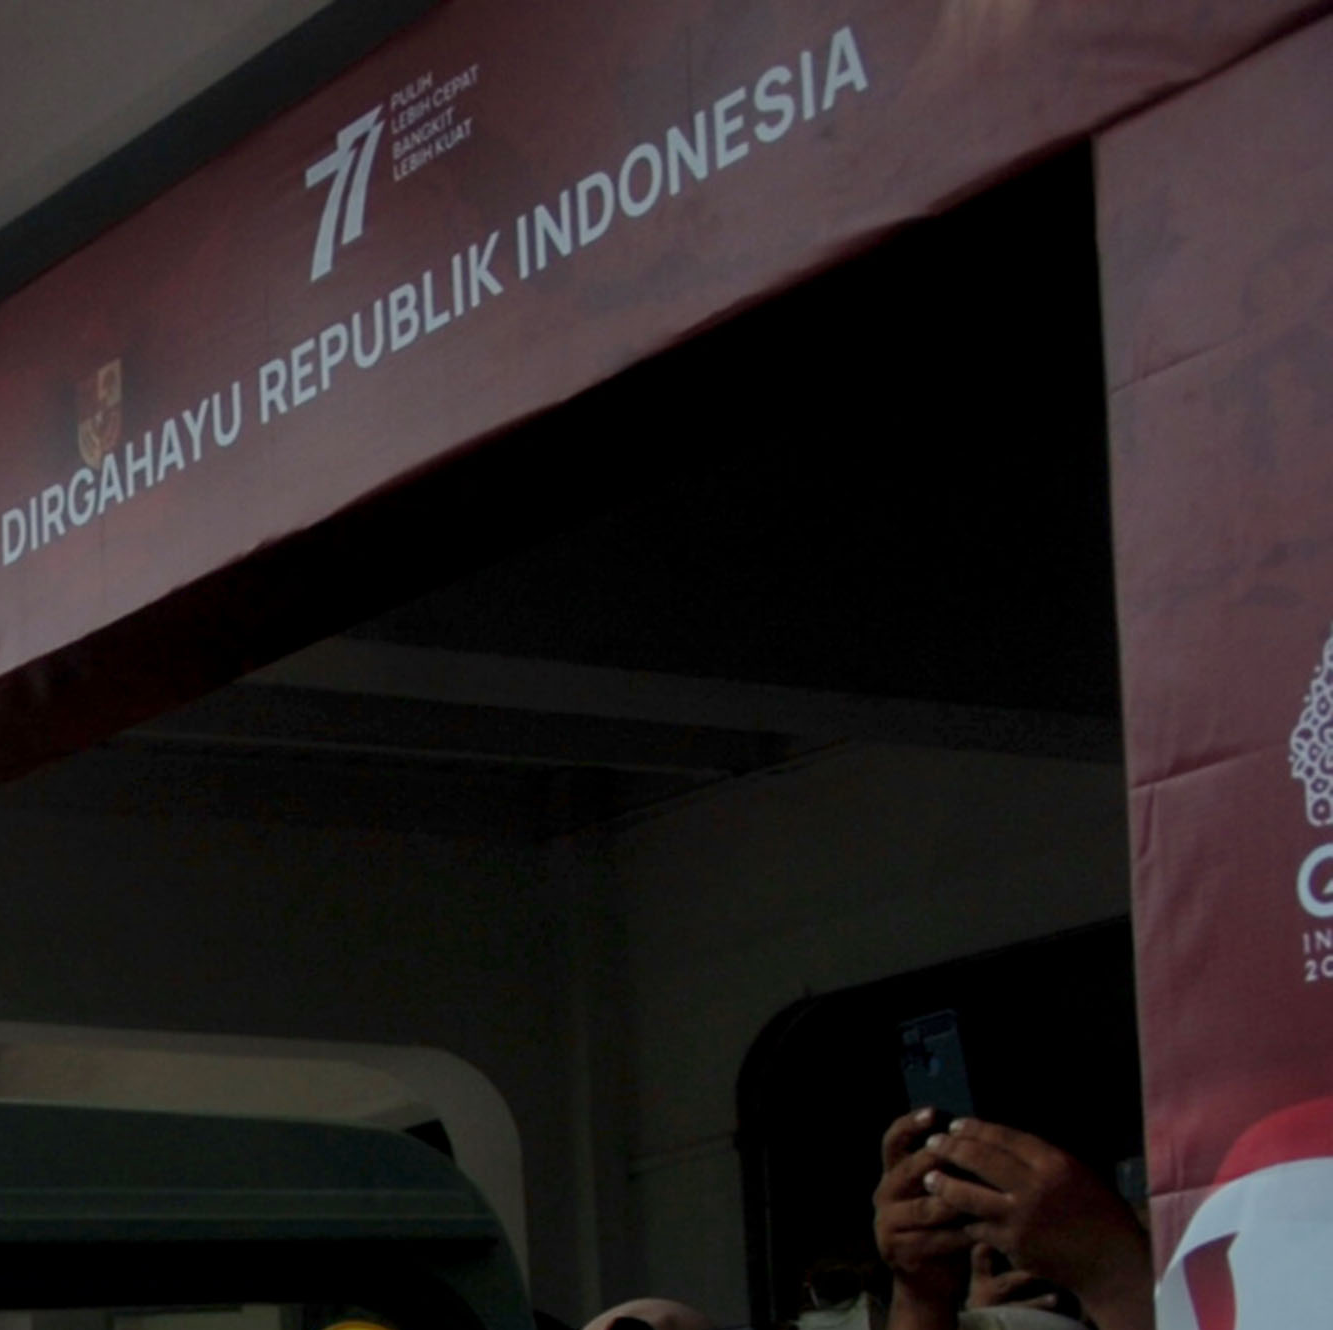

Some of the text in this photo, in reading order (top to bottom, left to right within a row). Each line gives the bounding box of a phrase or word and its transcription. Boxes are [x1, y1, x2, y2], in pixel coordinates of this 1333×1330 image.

[390, 71, 433, 110] PULIH
[390, 63, 479, 135] LEBIH CEPAT
[392, 105, 455, 160] BANGKIT
[393, 116, 473, 182] LEBIH KUAT
[305, 103, 385, 283] 77
[1, 26, 869, 567] DIRGAHAYU REPUBLIK INDONESIA
